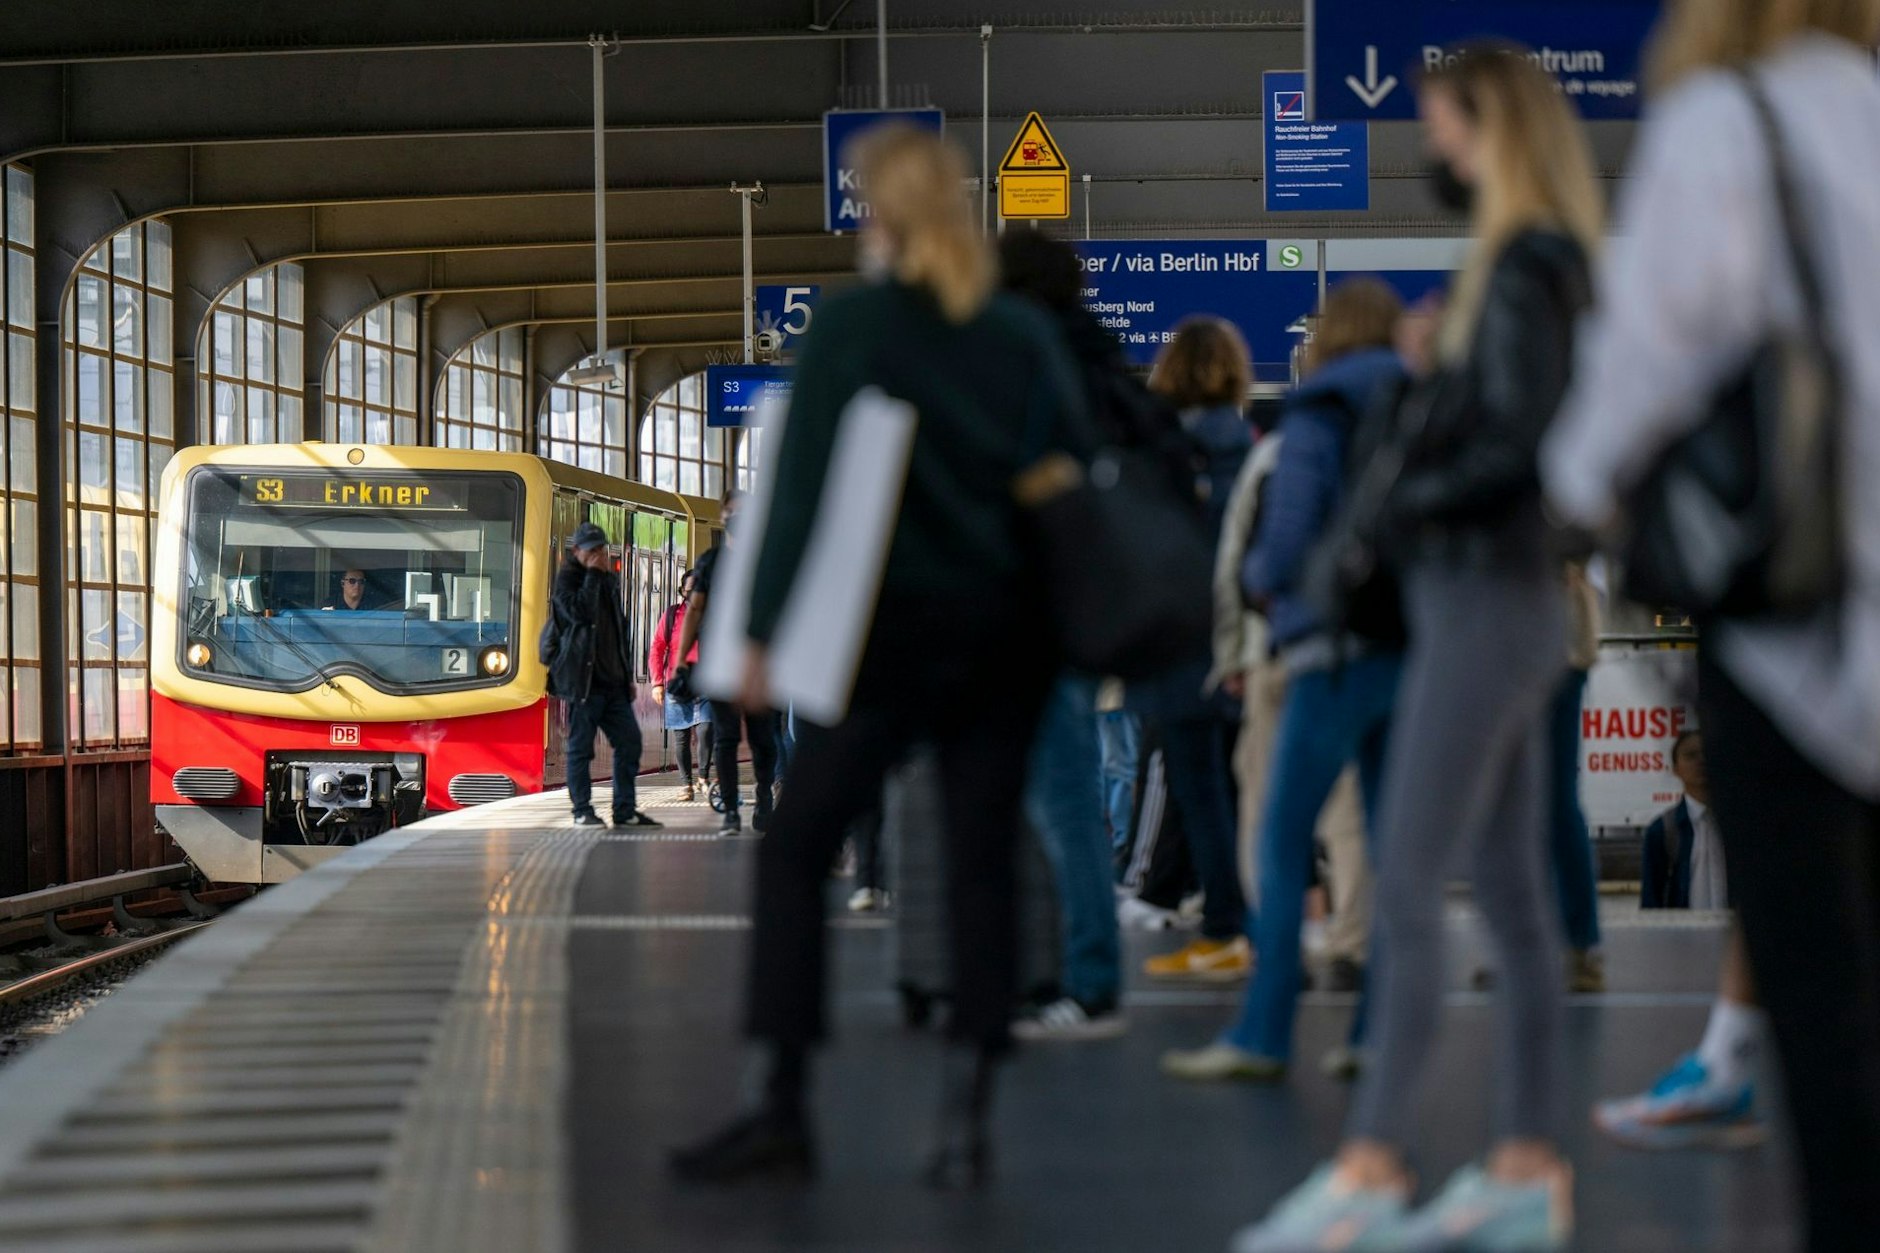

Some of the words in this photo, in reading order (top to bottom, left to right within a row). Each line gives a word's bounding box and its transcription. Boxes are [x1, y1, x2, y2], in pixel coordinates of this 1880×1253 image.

[1075, 253, 1107, 272] ber
[1111, 253, 1122, 272] /
[1126, 253, 1154, 272] via
[1160, 253, 1218, 272] Berlin
[1224, 252, 1260, 272] Hbf
[1079, 287, 1099, 297] ner
[783, 287, 813, 335] 5
[1083, 301, 1124, 315] usberg
[1126, 301, 1154, 313] Nord
[1129, 332, 1146, 343] via
[723, 381, 740, 393] S3
[764, 380, 795, 389] Tiergarte
[256, 479, 284, 502] S3
[324, 480, 430, 505] Erkner
[448, 649, 461, 671] 2
[1582, 706, 1686, 739] HAUSE
[334, 728, 356, 742] DB
[1588, 752, 1669, 772] GENUSS.
